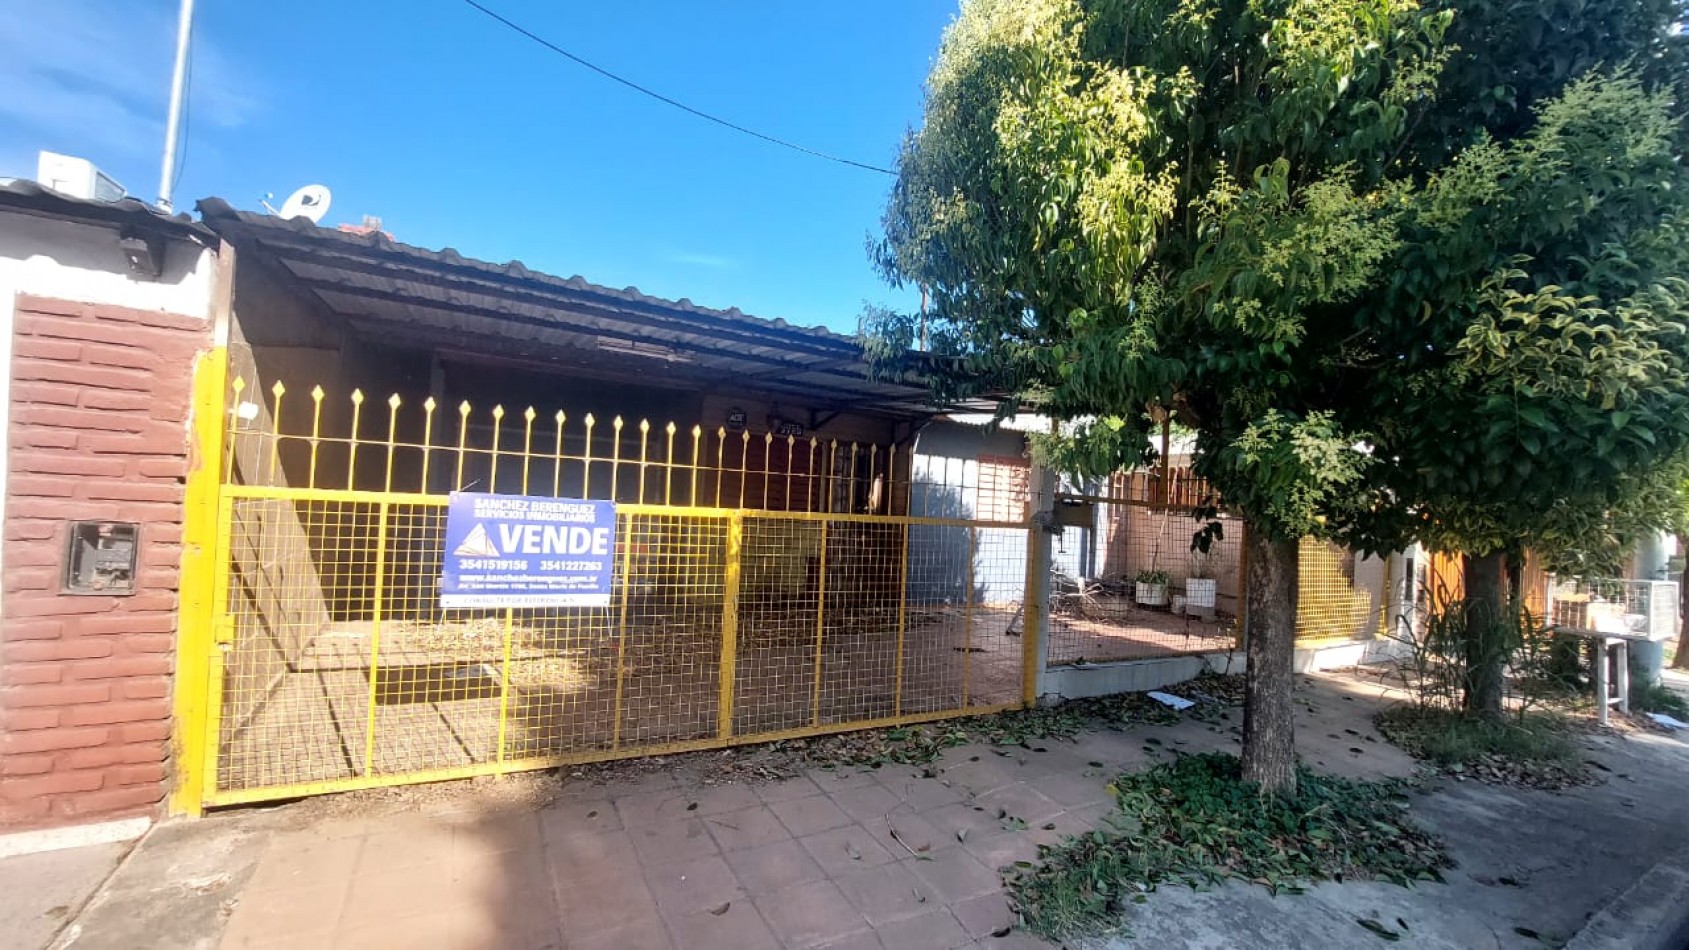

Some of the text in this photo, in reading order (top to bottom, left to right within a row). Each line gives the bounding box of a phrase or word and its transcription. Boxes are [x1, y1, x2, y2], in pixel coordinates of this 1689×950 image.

[474, 498, 596, 513] SANCHEZ BERENGUEZ
[474, 509, 596, 524] SERVICIOS INMOBILIARIOS
[498, 523, 609, 555] VENDE
